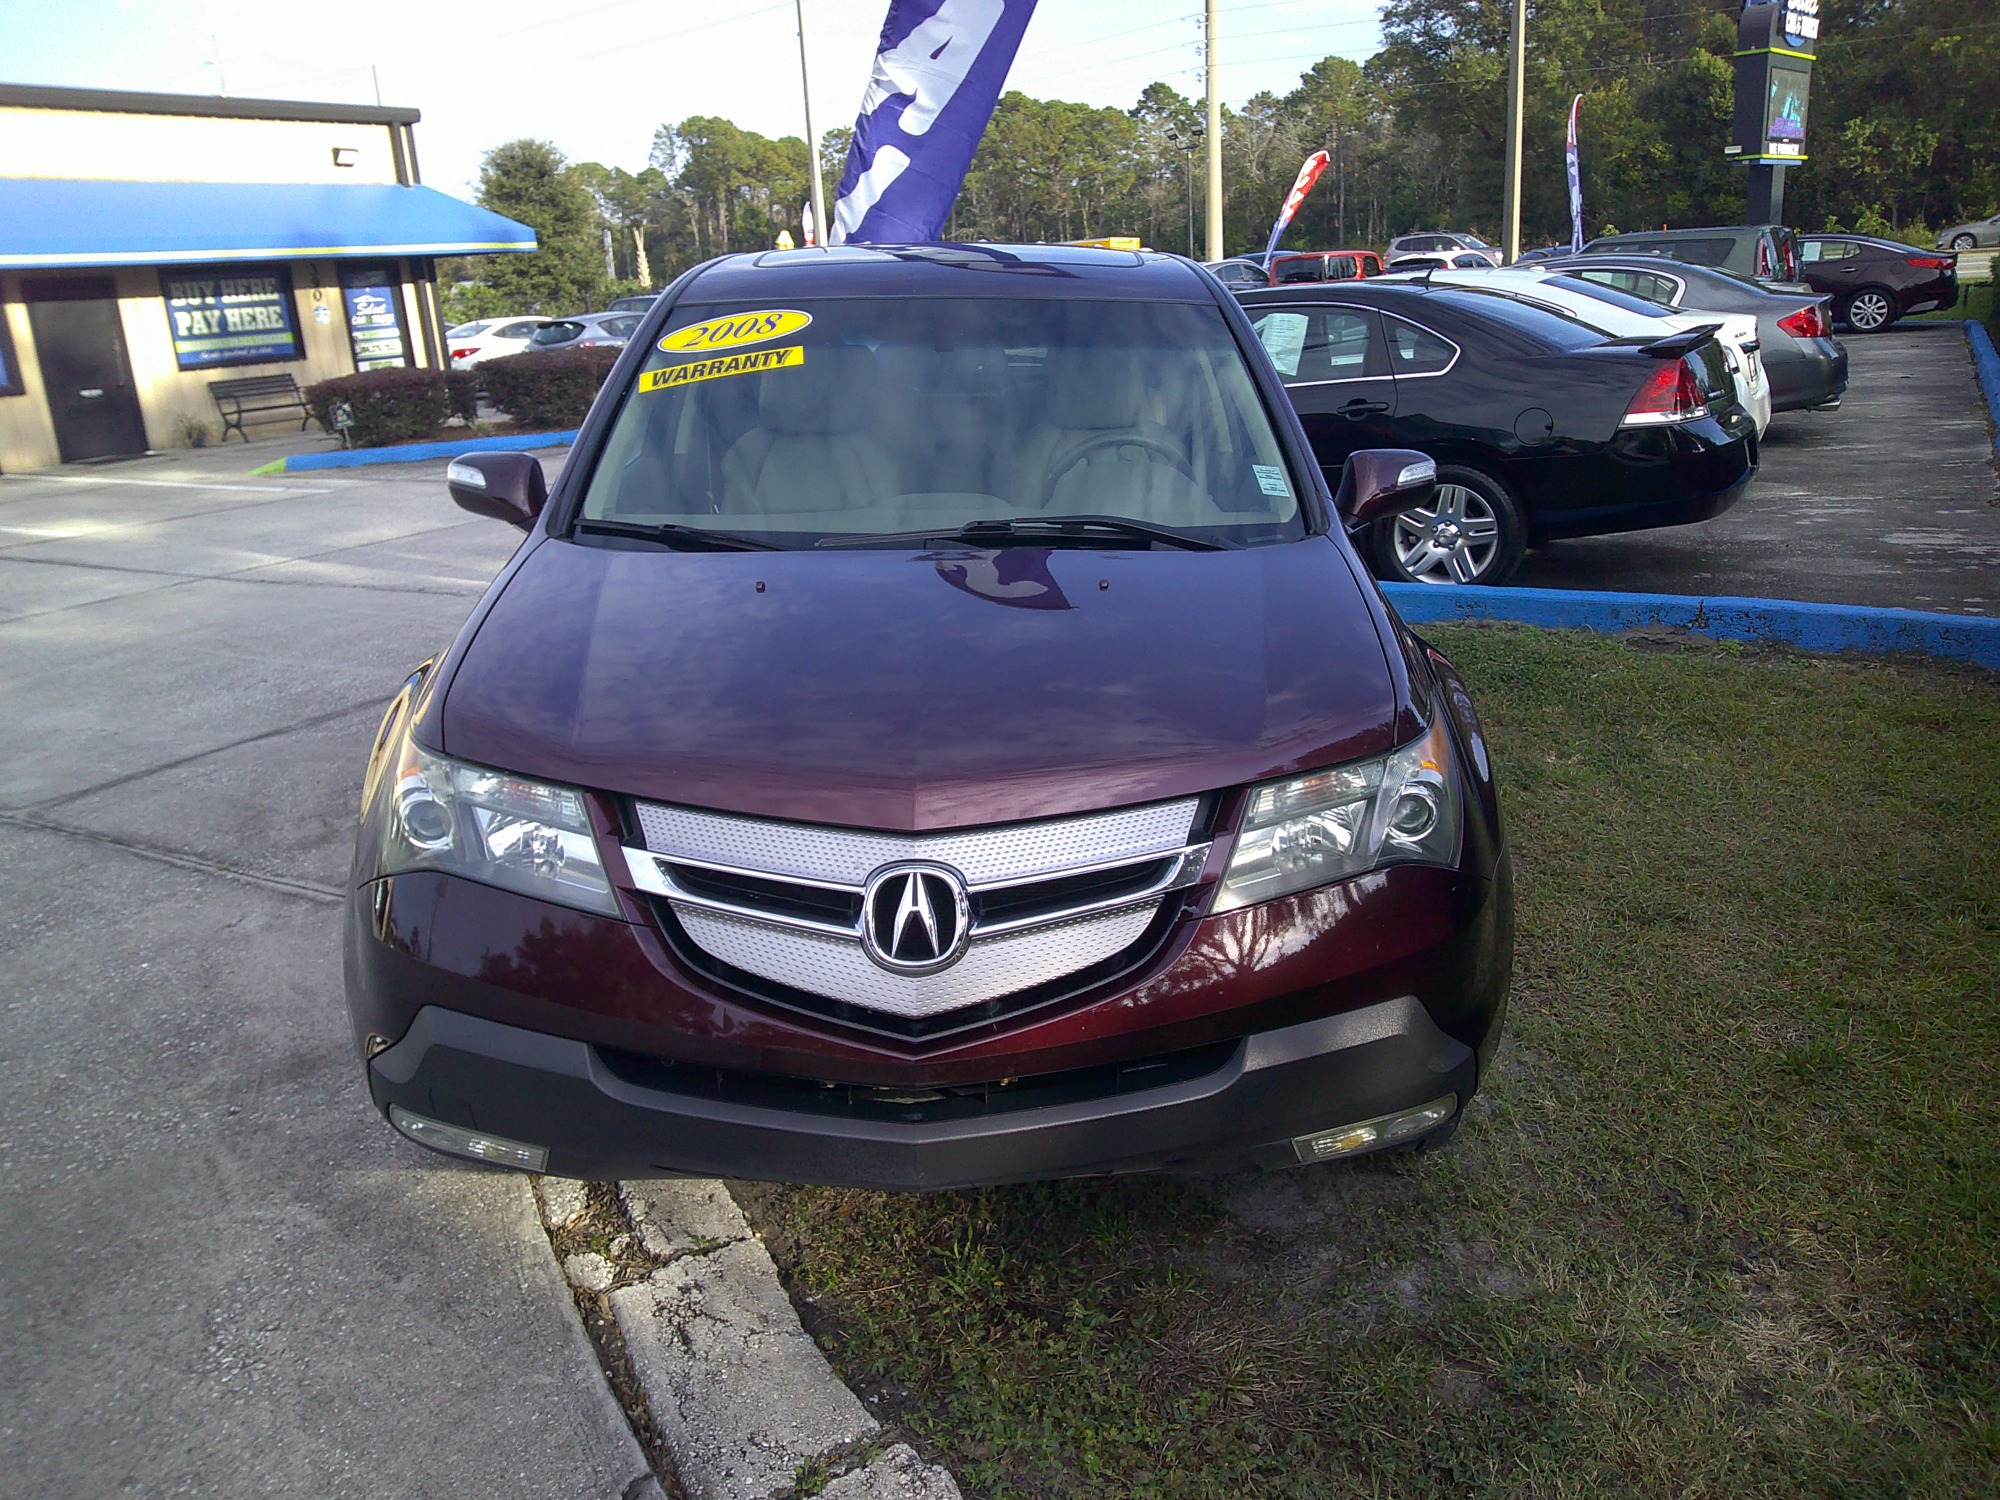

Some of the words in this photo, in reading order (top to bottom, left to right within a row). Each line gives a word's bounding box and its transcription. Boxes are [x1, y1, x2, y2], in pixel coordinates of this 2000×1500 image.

[168, 279, 216, 307] BUY
[218, 277, 280, 304] HERE
[173, 308, 221, 337] PAY
[223, 305, 285, 332] HERE
[682, 313, 783, 348] 2008
[651, 349, 794, 387] WARRANTY
